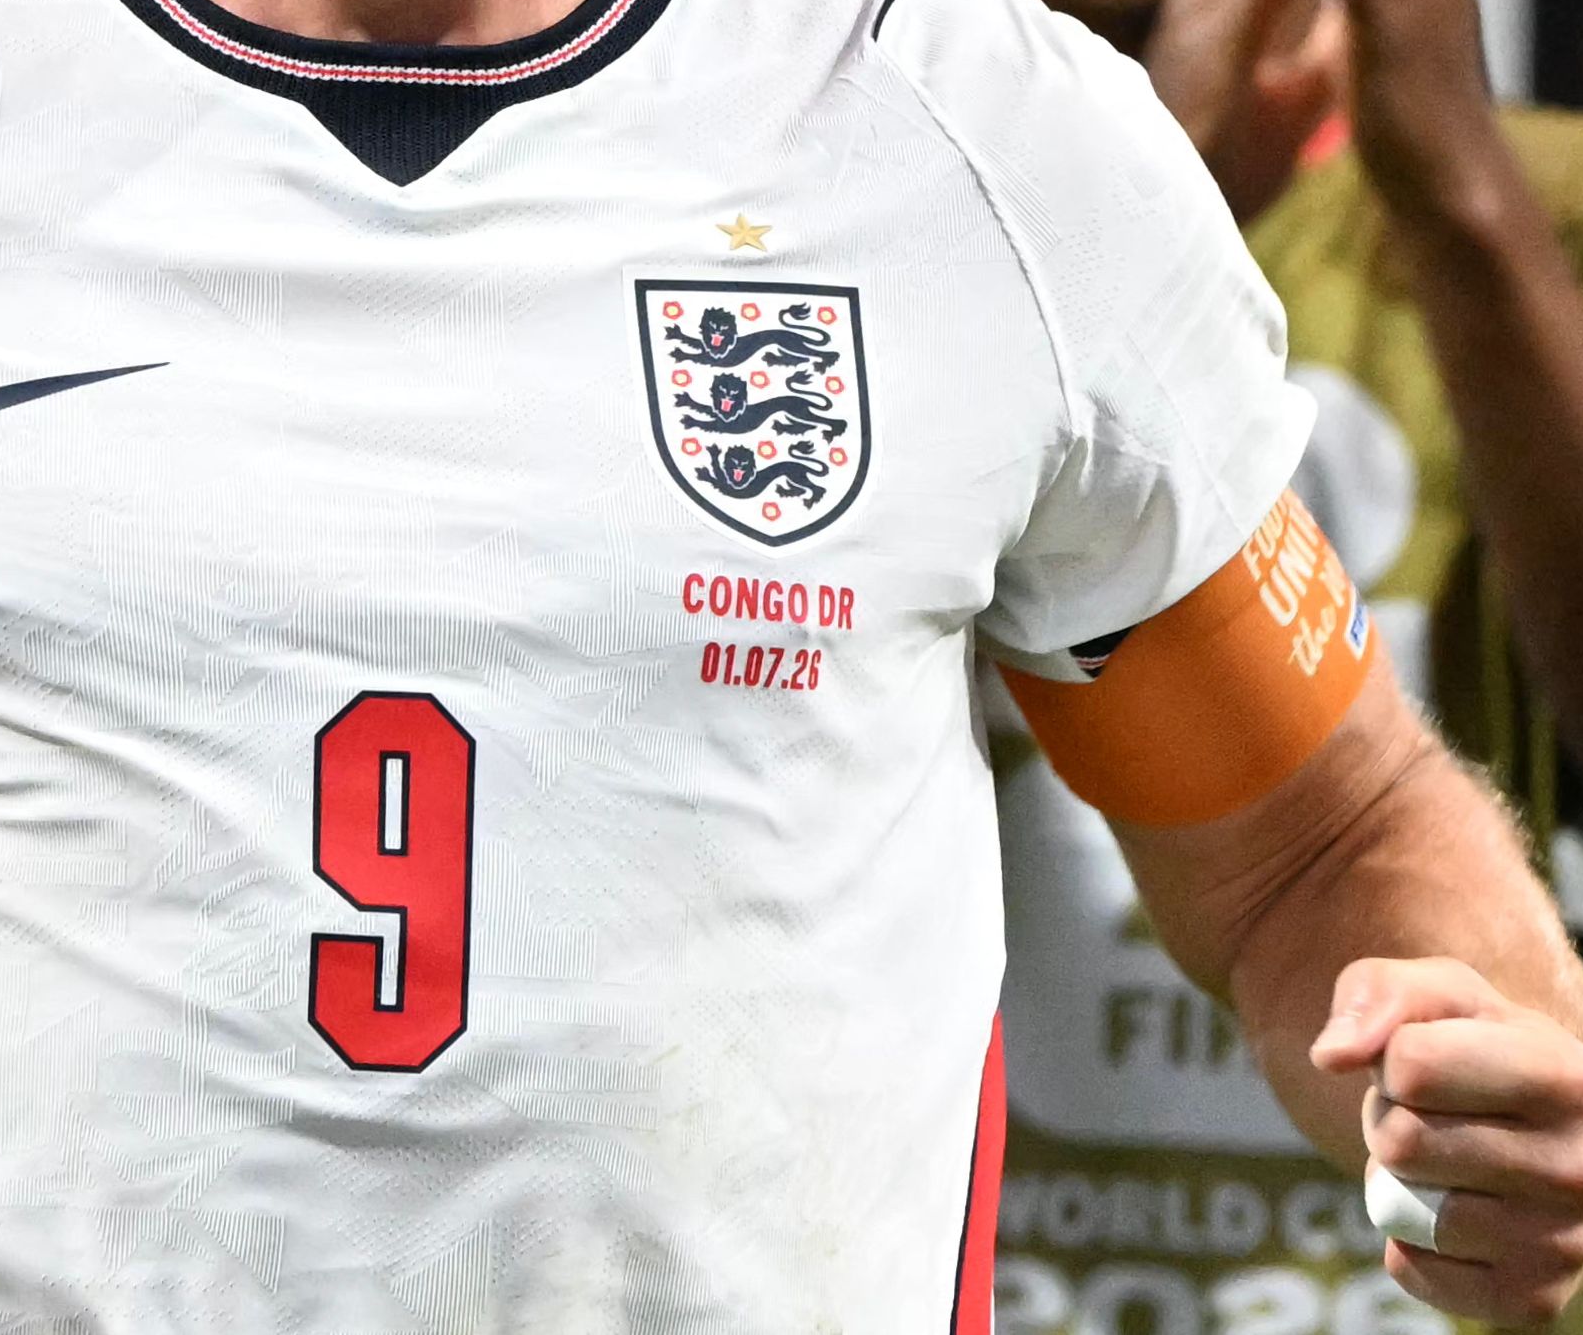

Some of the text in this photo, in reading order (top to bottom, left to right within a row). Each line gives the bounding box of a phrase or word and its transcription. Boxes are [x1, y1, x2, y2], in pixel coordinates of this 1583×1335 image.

[683, 573, 854, 630] CONGO DR
[700, 641, 822, 690] 01.07.26
[308, 690, 476, 1073] 9
[1280, 1181, 1384, 1260] CU
